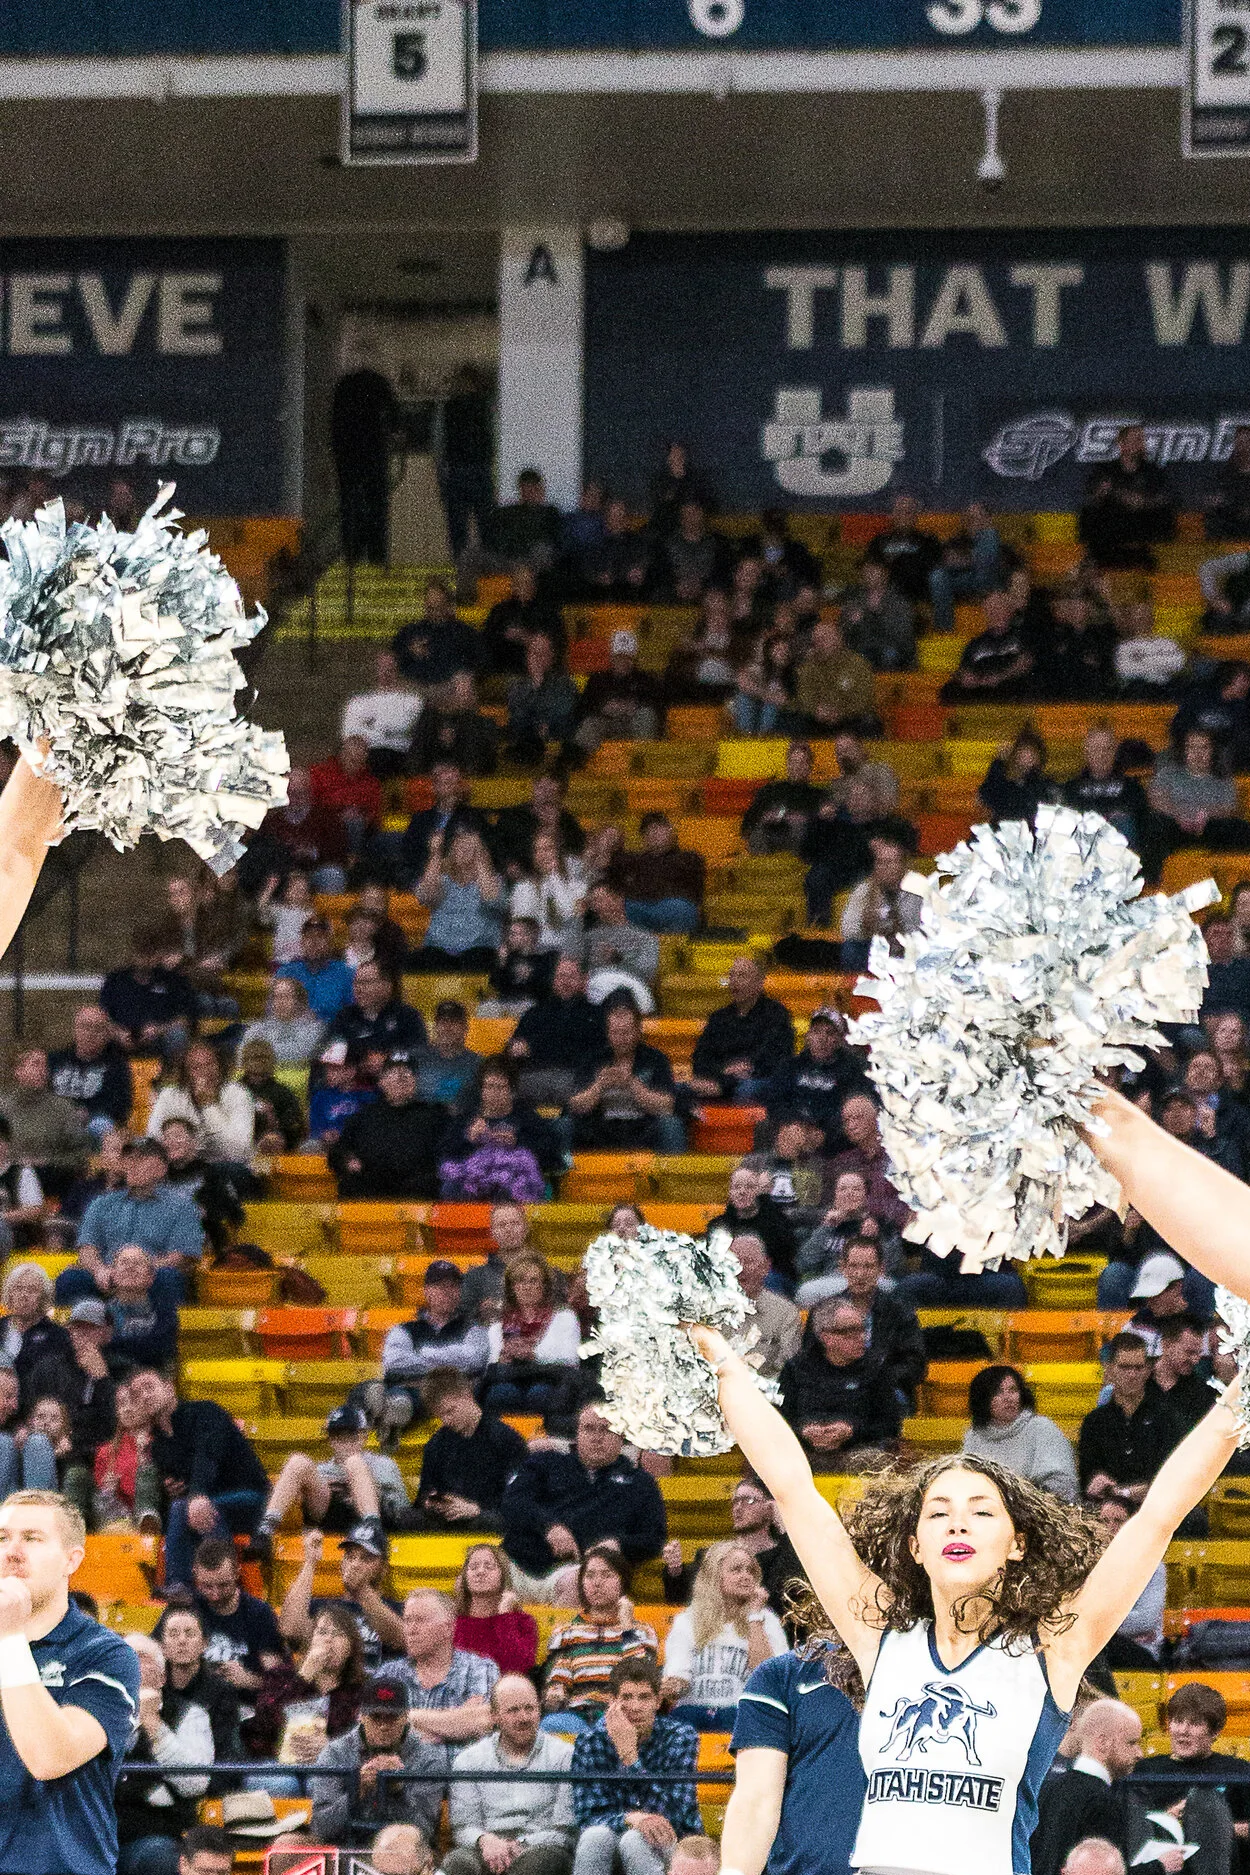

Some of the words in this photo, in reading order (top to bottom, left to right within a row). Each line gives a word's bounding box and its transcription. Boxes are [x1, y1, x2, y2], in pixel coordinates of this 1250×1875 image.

[394, 31, 428, 80] 5
[523, 243, 558, 286] A
[0, 270, 224, 356] EVE
[764, 261, 1084, 350] THAT
